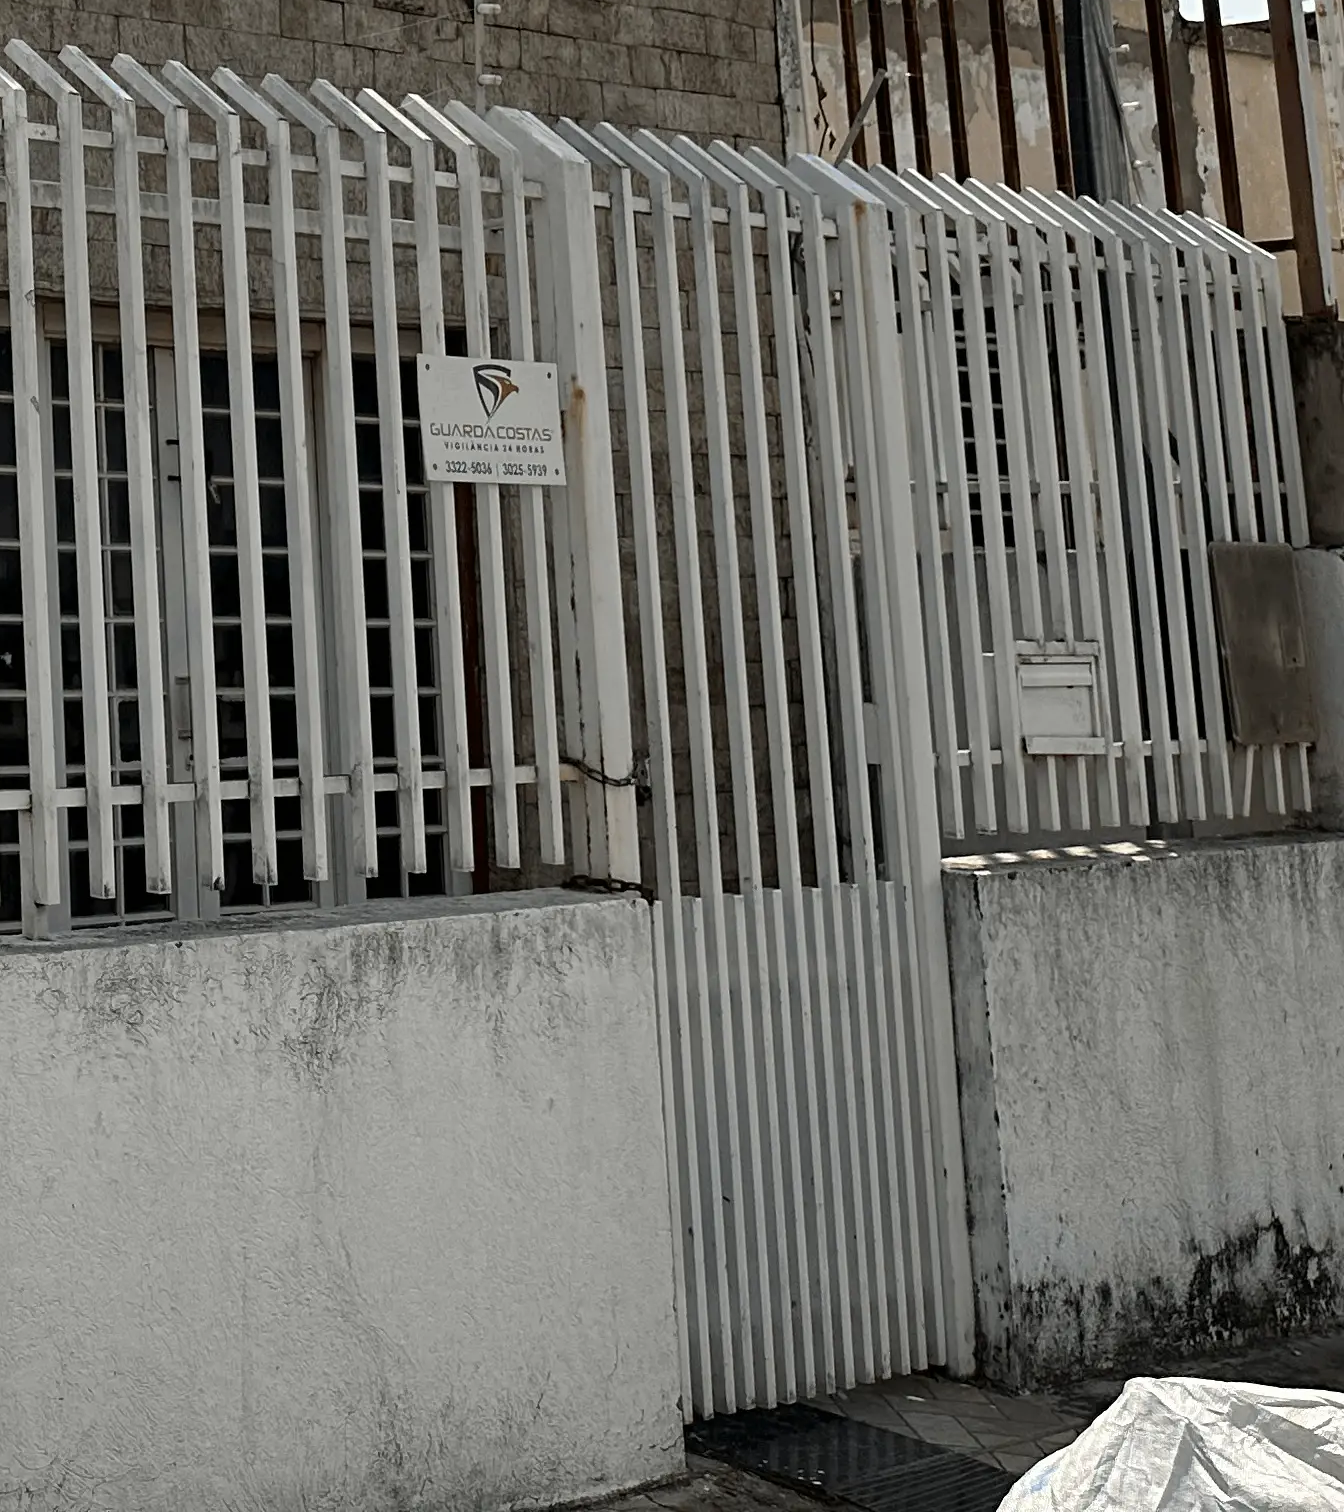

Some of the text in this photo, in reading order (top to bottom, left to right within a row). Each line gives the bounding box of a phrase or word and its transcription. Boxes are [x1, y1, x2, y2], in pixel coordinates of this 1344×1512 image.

[429, 421, 552, 442] GUARDACOSTAS
[502, 444, 513, 453] 24
[515, 444, 545, 454] HORAS
[444, 460, 548, 477] 3322-5036 3025-5939
